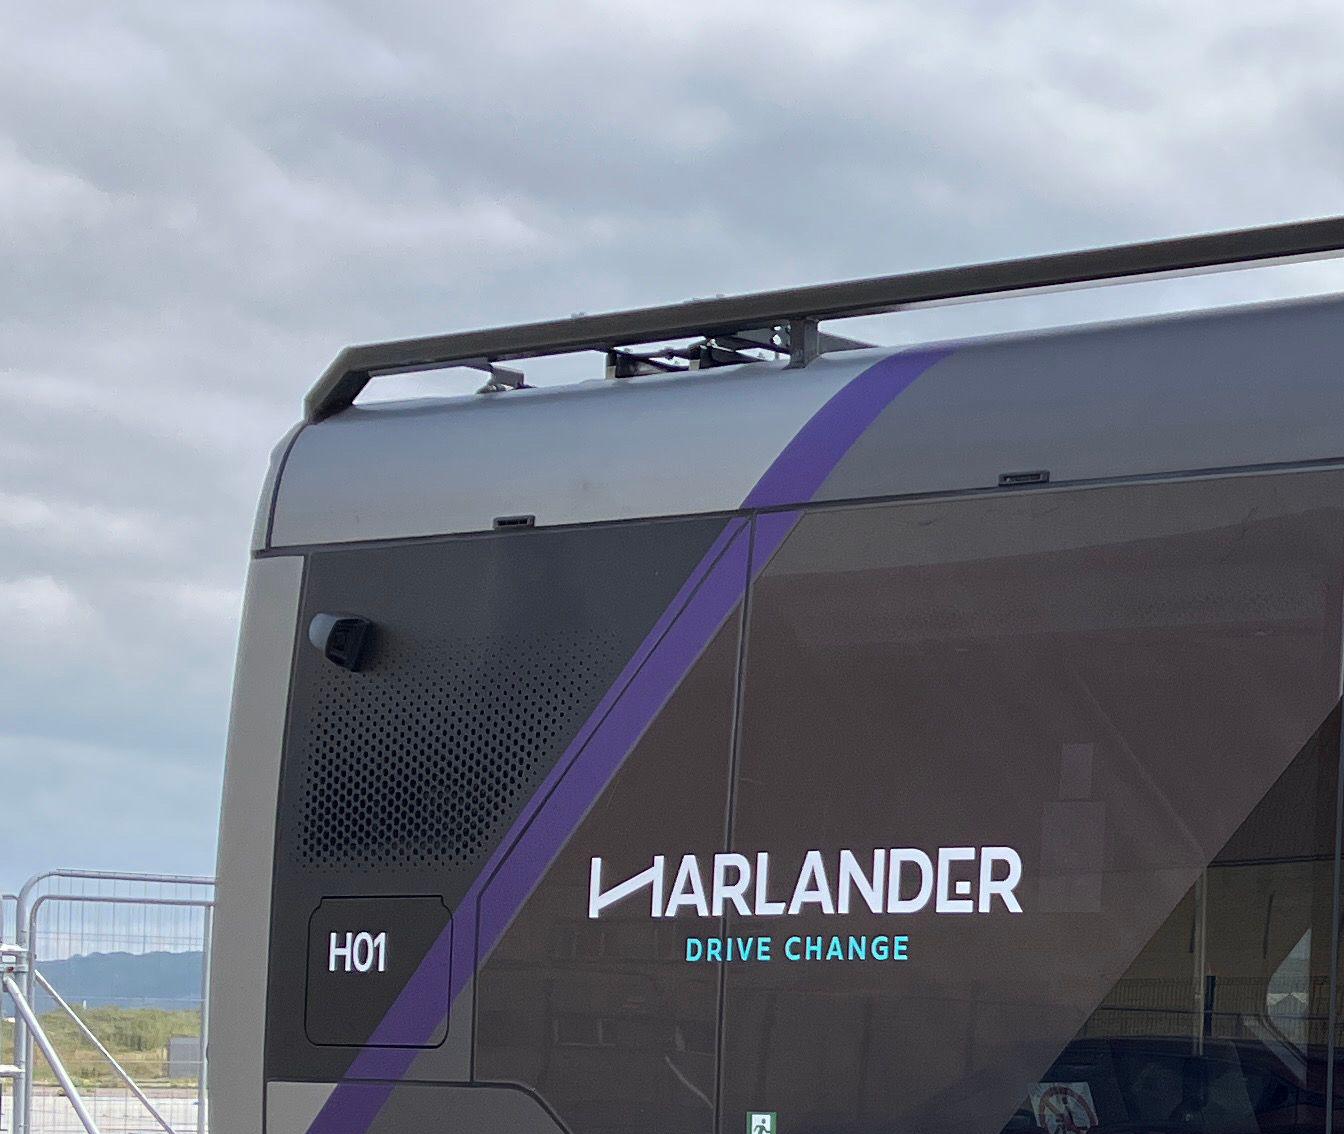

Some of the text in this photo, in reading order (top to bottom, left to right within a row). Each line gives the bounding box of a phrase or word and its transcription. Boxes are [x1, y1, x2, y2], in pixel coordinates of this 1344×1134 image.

[588, 846, 1024, 919] HARLANDER
[328, 931, 387, 972] H01
[685, 935, 909, 962] DRIVE CHANGE
